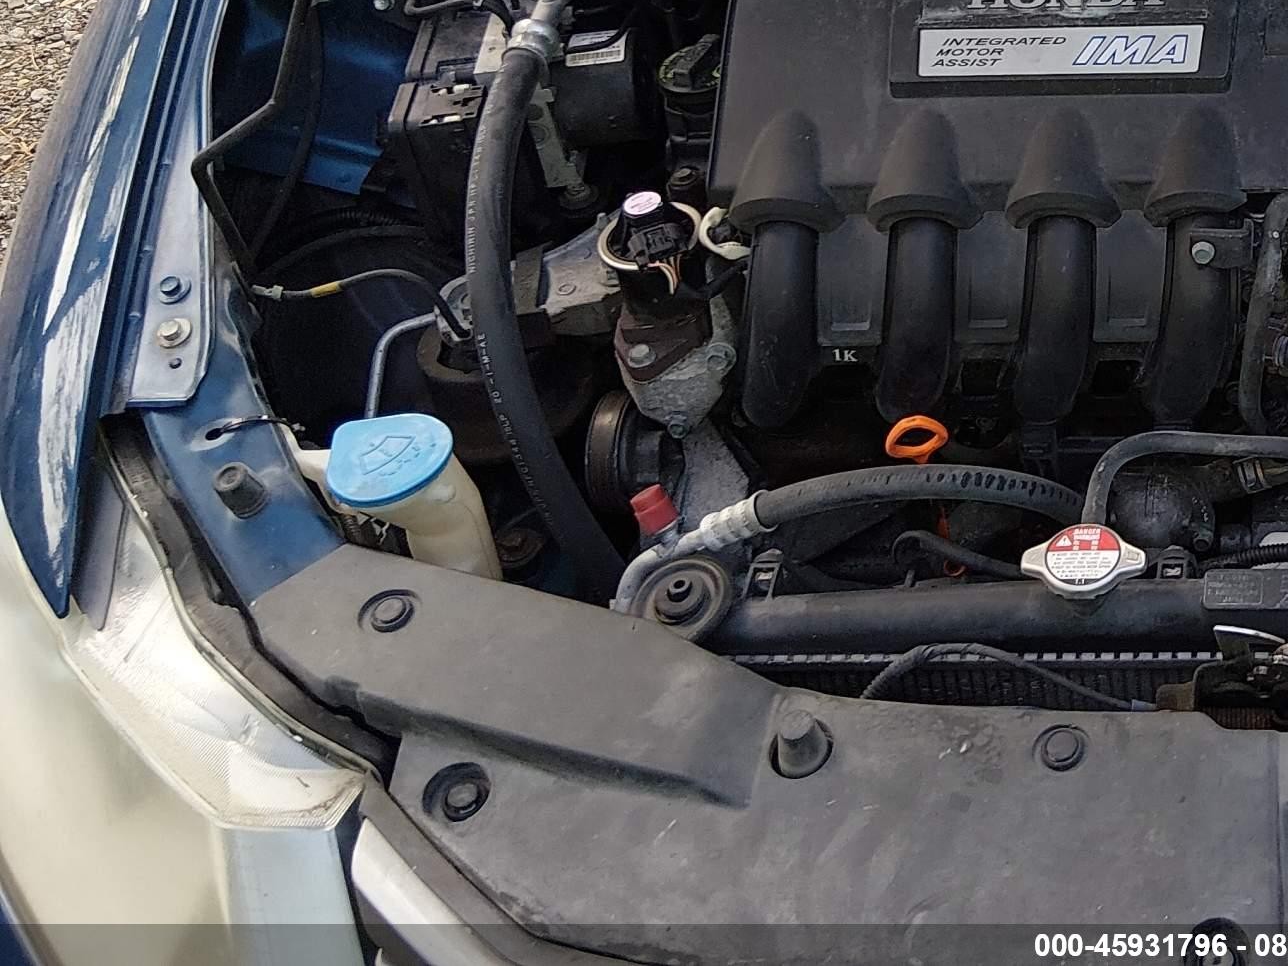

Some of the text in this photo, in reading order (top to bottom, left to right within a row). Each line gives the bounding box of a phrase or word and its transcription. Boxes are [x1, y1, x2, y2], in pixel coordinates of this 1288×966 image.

[942, 36, 1067, 46] INTEGRATED
[936, 48, 1004, 57] MOTOR
[1073, 34, 1189, 66] IMA
[932, 58, 1002, 68] ASSIST
[467, 226, 476, 273] NICHIRIN
[832, 348, 858, 362] 1K
